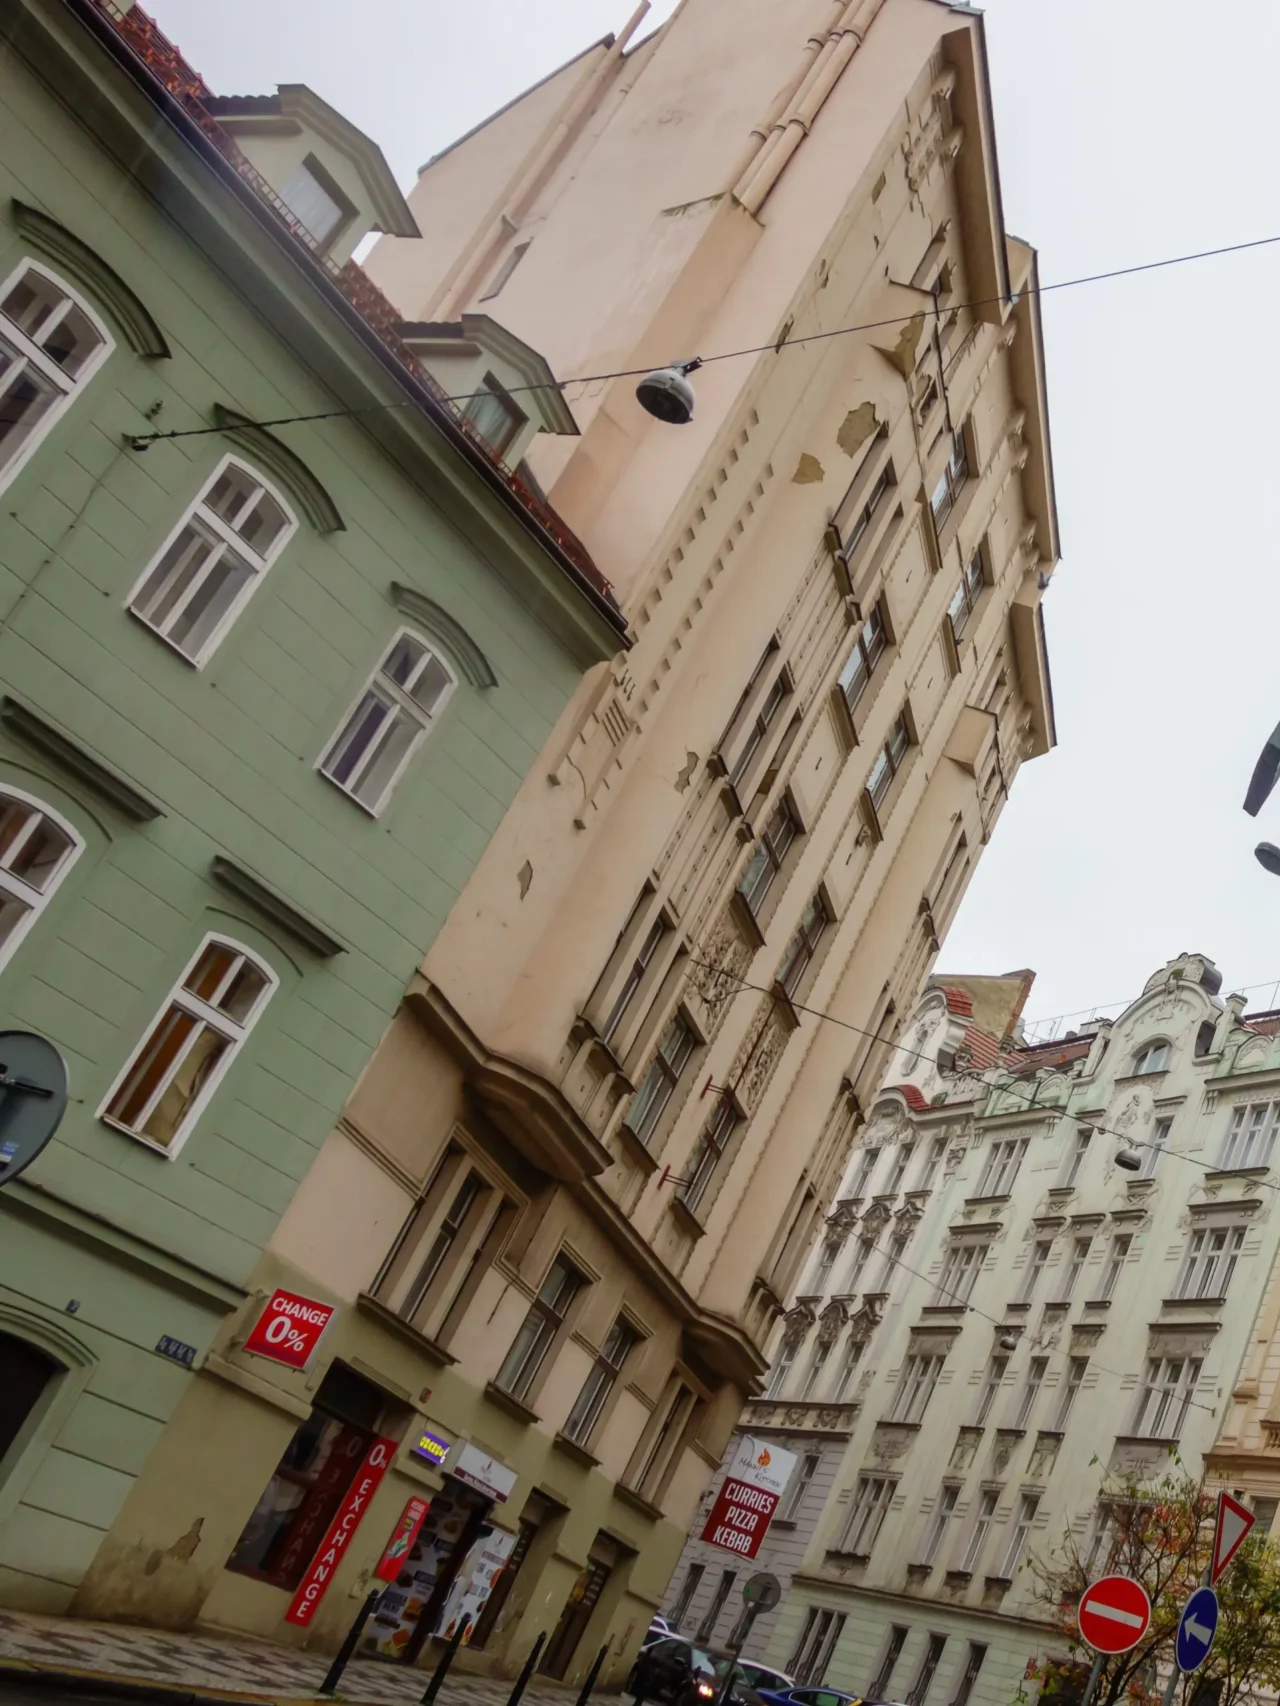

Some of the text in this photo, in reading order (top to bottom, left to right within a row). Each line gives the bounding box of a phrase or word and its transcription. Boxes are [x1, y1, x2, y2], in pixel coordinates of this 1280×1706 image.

[271, 1296, 329, 1327] CHANGE
[264, 1315, 305, 1352] 0%
[368, 1443, 388, 1469] 0%
[725, 1483, 774, 1514] CURRIES
[725, 1506, 758, 1531] PIZZA
[295, 1477, 373, 1619] EXCHANGE
[713, 1526, 752, 1553] KEBAB
